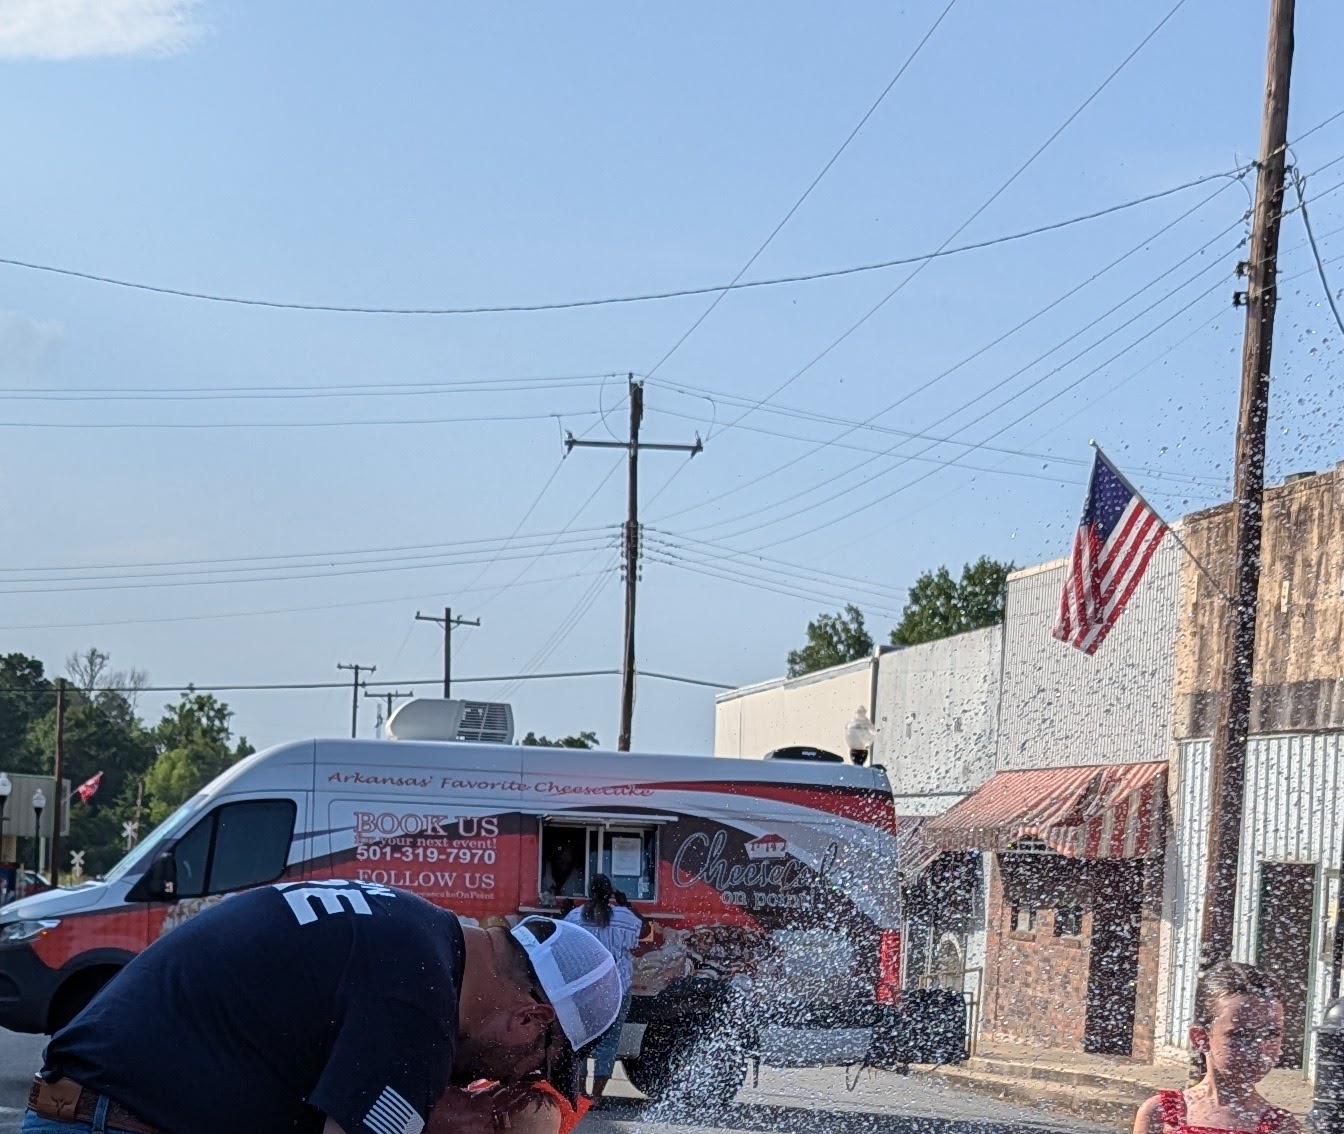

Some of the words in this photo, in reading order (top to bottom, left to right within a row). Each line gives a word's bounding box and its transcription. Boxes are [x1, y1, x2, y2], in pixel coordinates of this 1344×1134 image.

[328, 771, 433, 787] Arkansas'
[440, 776, 531, 791] Favorite
[533, 781, 654, 797] Cheesecake
[353, 812, 448, 836] BOOK
[455, 816, 499, 837] US
[380, 837, 413, 847] your
[416, 838, 449, 847] next
[453, 839, 497, 849] event!
[356, 846, 496, 864] 501-319-7970
[358, 869, 457, 887] FOLLOW
[465, 873, 495, 889] US
[721, 890, 748, 906] on
